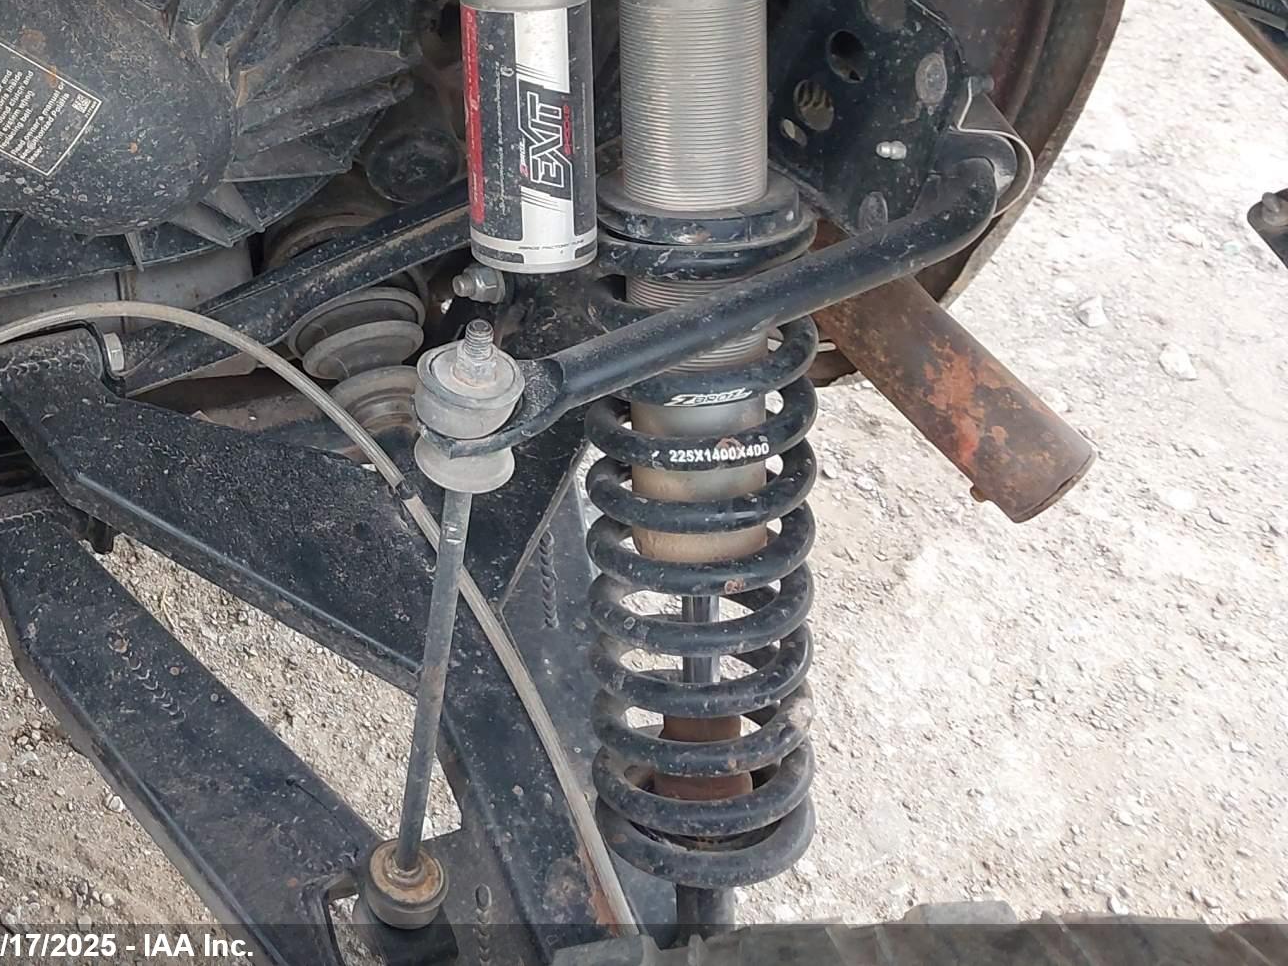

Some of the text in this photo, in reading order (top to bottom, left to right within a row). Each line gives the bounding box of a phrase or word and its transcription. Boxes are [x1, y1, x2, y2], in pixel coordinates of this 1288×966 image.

[2, 69, 12, 84] and
[6, 71, 22, 93] inside
[9, 85, 26, 106] clutch
[23, 70, 34, 85] and
[42, 90, 61, 116] manual
[58, 81, 65, 90] or
[52, 93, 70, 117] Polaris
[2, 109, 20, 132] system
[0, 121, 24, 149] replacing
[527, 91, 565, 188] EXIT
[669, 442, 770, 463] 225X1400X400
